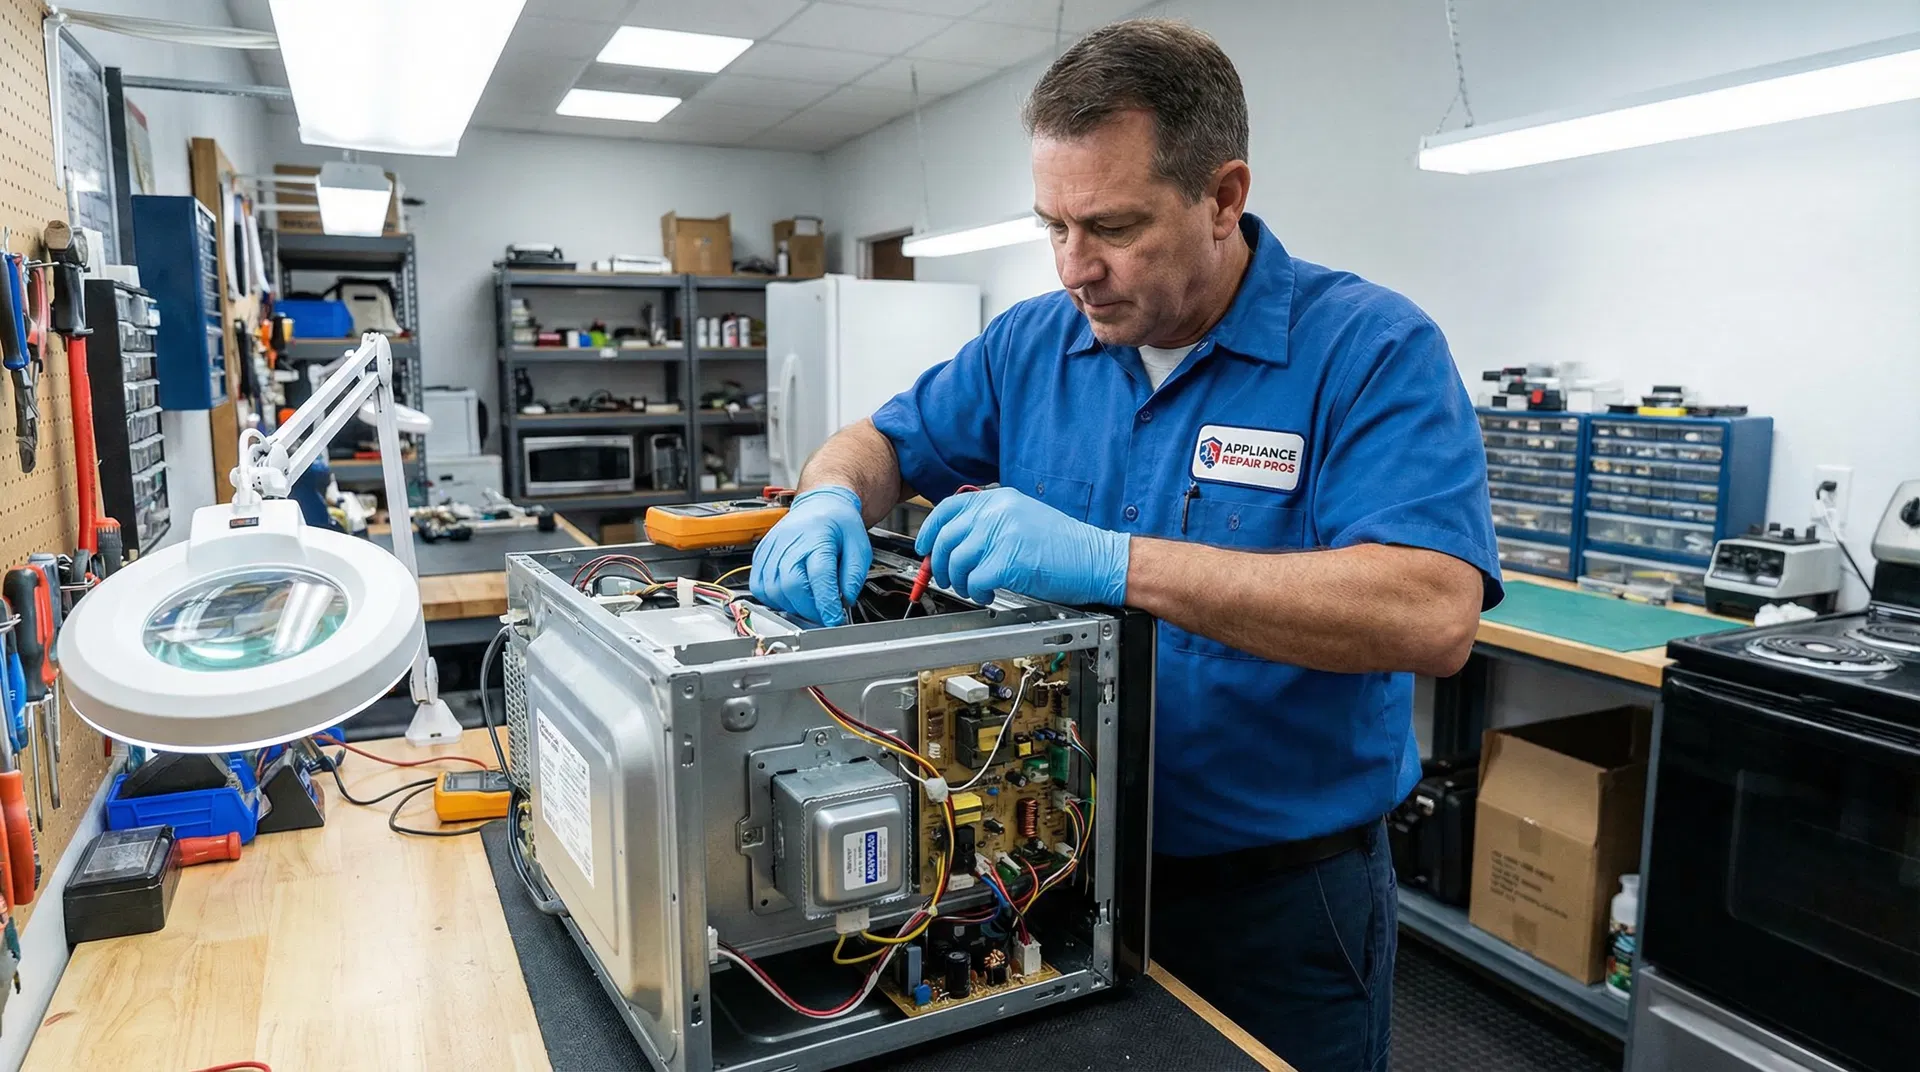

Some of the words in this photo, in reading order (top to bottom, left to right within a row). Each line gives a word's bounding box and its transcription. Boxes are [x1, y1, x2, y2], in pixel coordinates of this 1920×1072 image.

[1224, 443, 1297, 461] APPLIANCE
[1222, 455, 1261, 469] REPAIR
[1263, 460, 1295, 473] PROS
